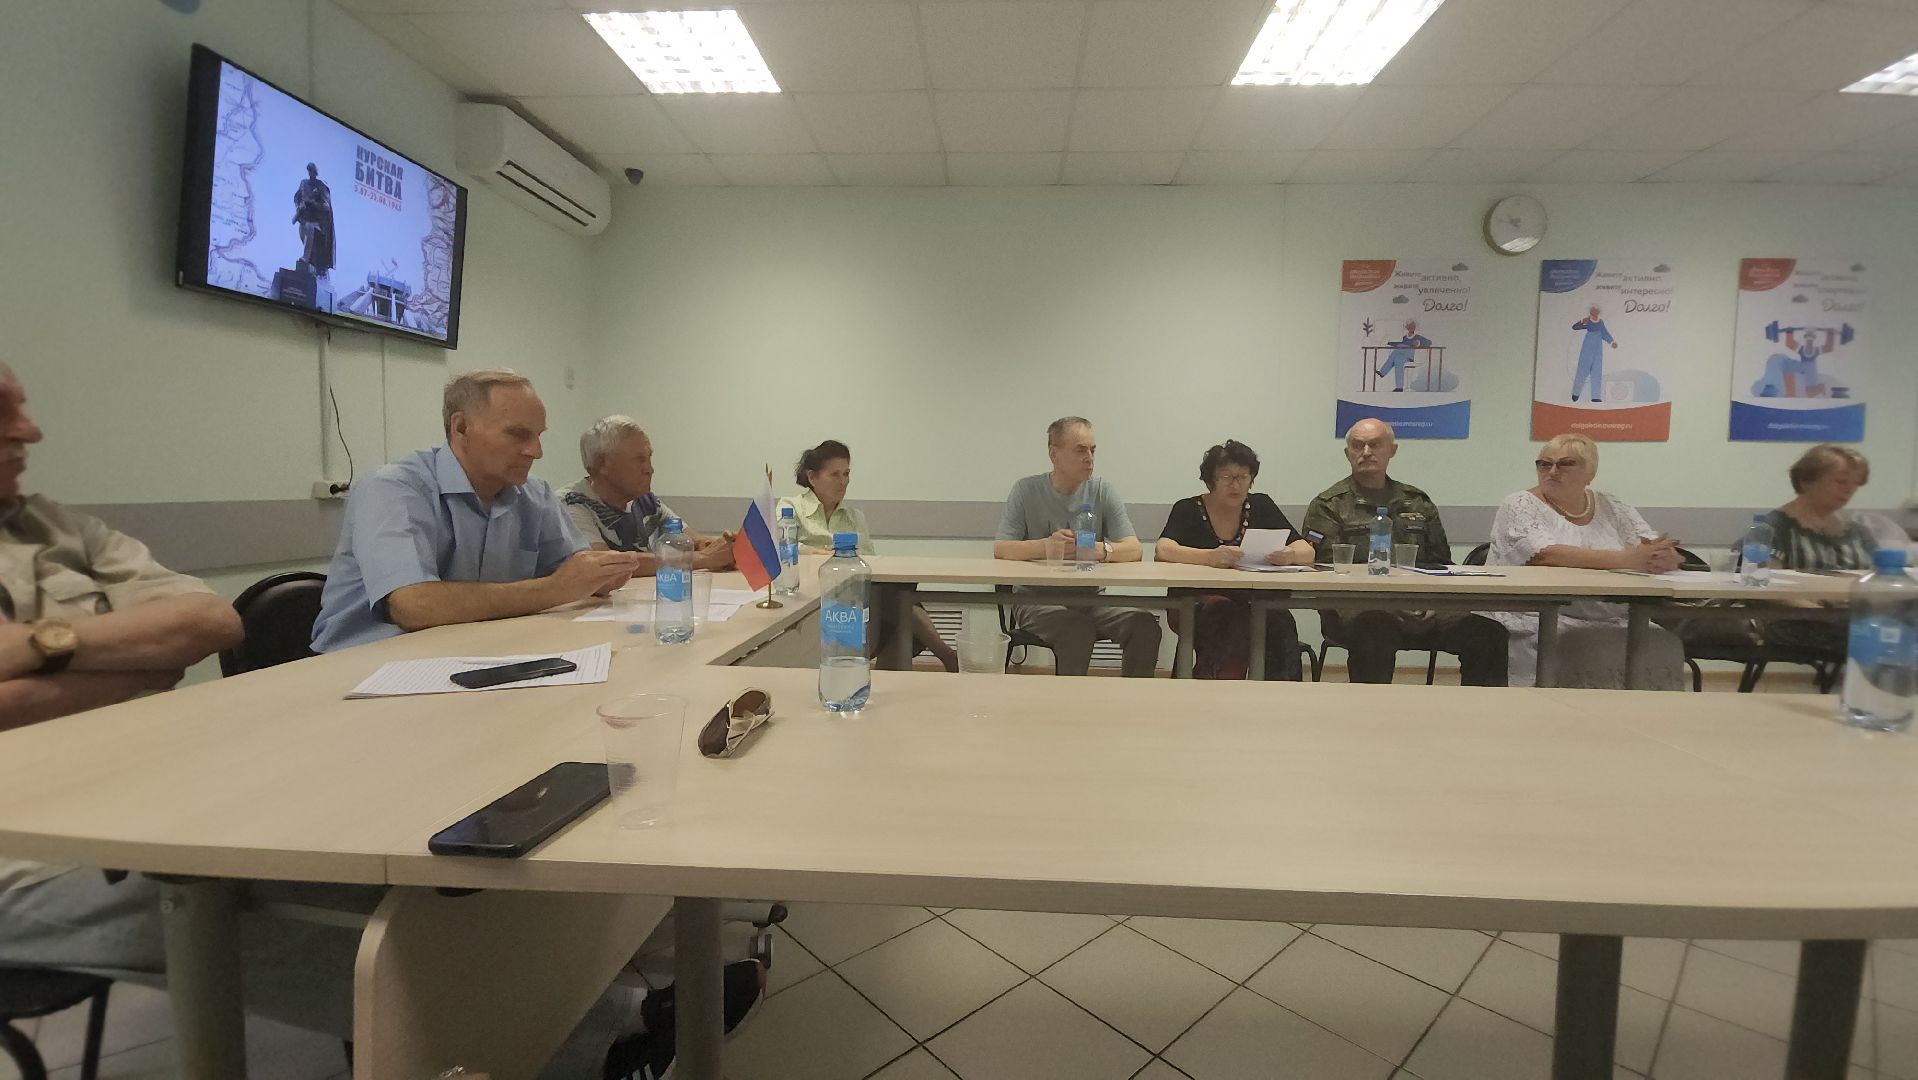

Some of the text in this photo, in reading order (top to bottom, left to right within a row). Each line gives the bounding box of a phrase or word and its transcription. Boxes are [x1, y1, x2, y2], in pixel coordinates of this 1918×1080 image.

[356, 144, 404, 180] КУРСКАЯ
[355, 160, 402, 200] БИТВА
[1422, 298, 1469, 312] Долго!
[1624, 299, 1672, 313] Долго!
[825, 609, 857, 624] АКВА
